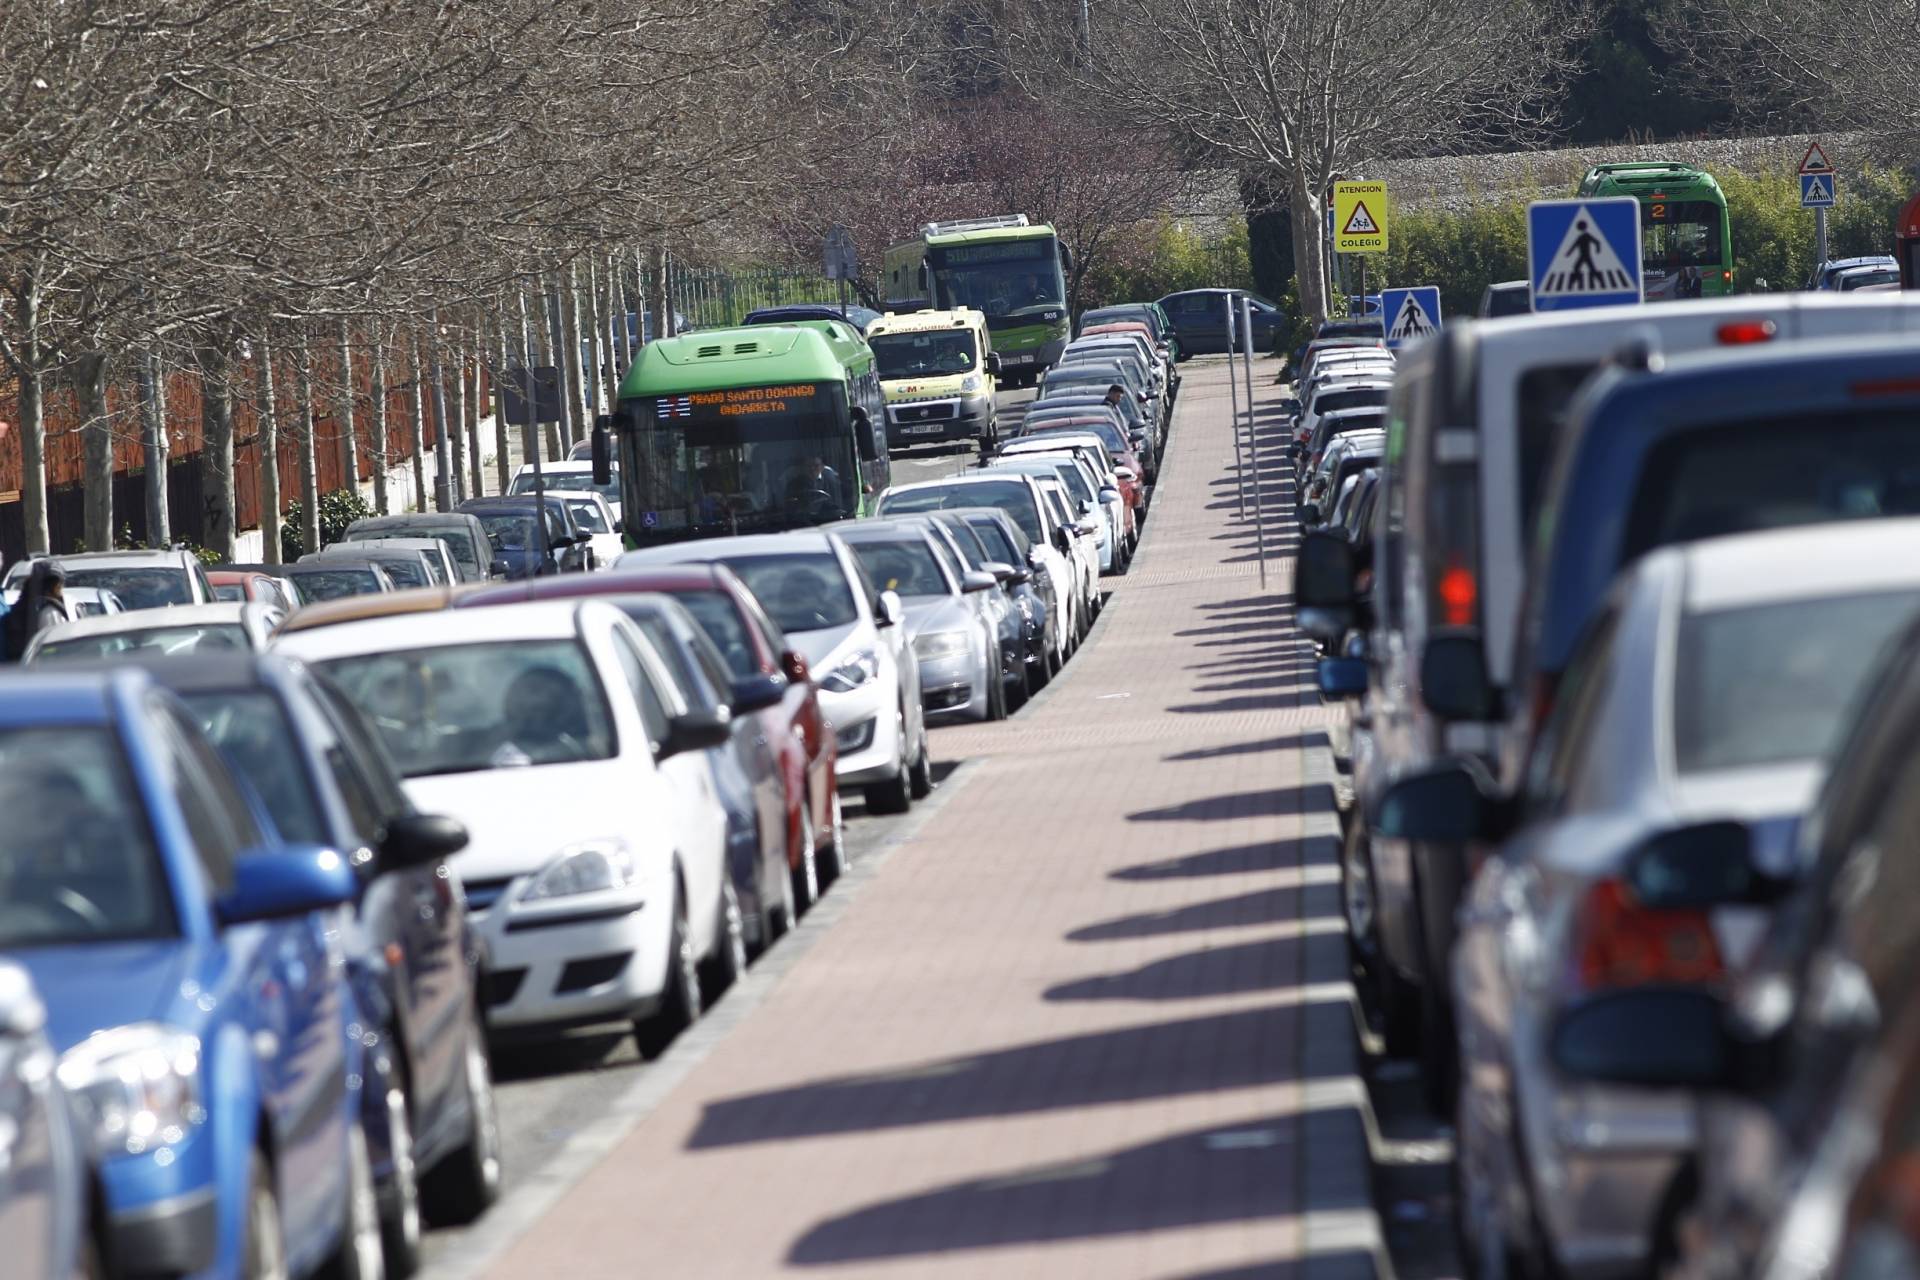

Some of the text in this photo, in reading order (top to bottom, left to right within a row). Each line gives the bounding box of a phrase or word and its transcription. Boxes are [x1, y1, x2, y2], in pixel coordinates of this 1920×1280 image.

[1339, 186, 1382, 194] ATENCION
[1652, 204, 1665, 218] 2
[1341, 239, 1381, 247] COLEGIO
[1044, 312, 1057, 320] 505
[689, 385, 815, 404] PRADO SANTO DOMINGO
[720, 401, 785, 415] ONDARRETA
